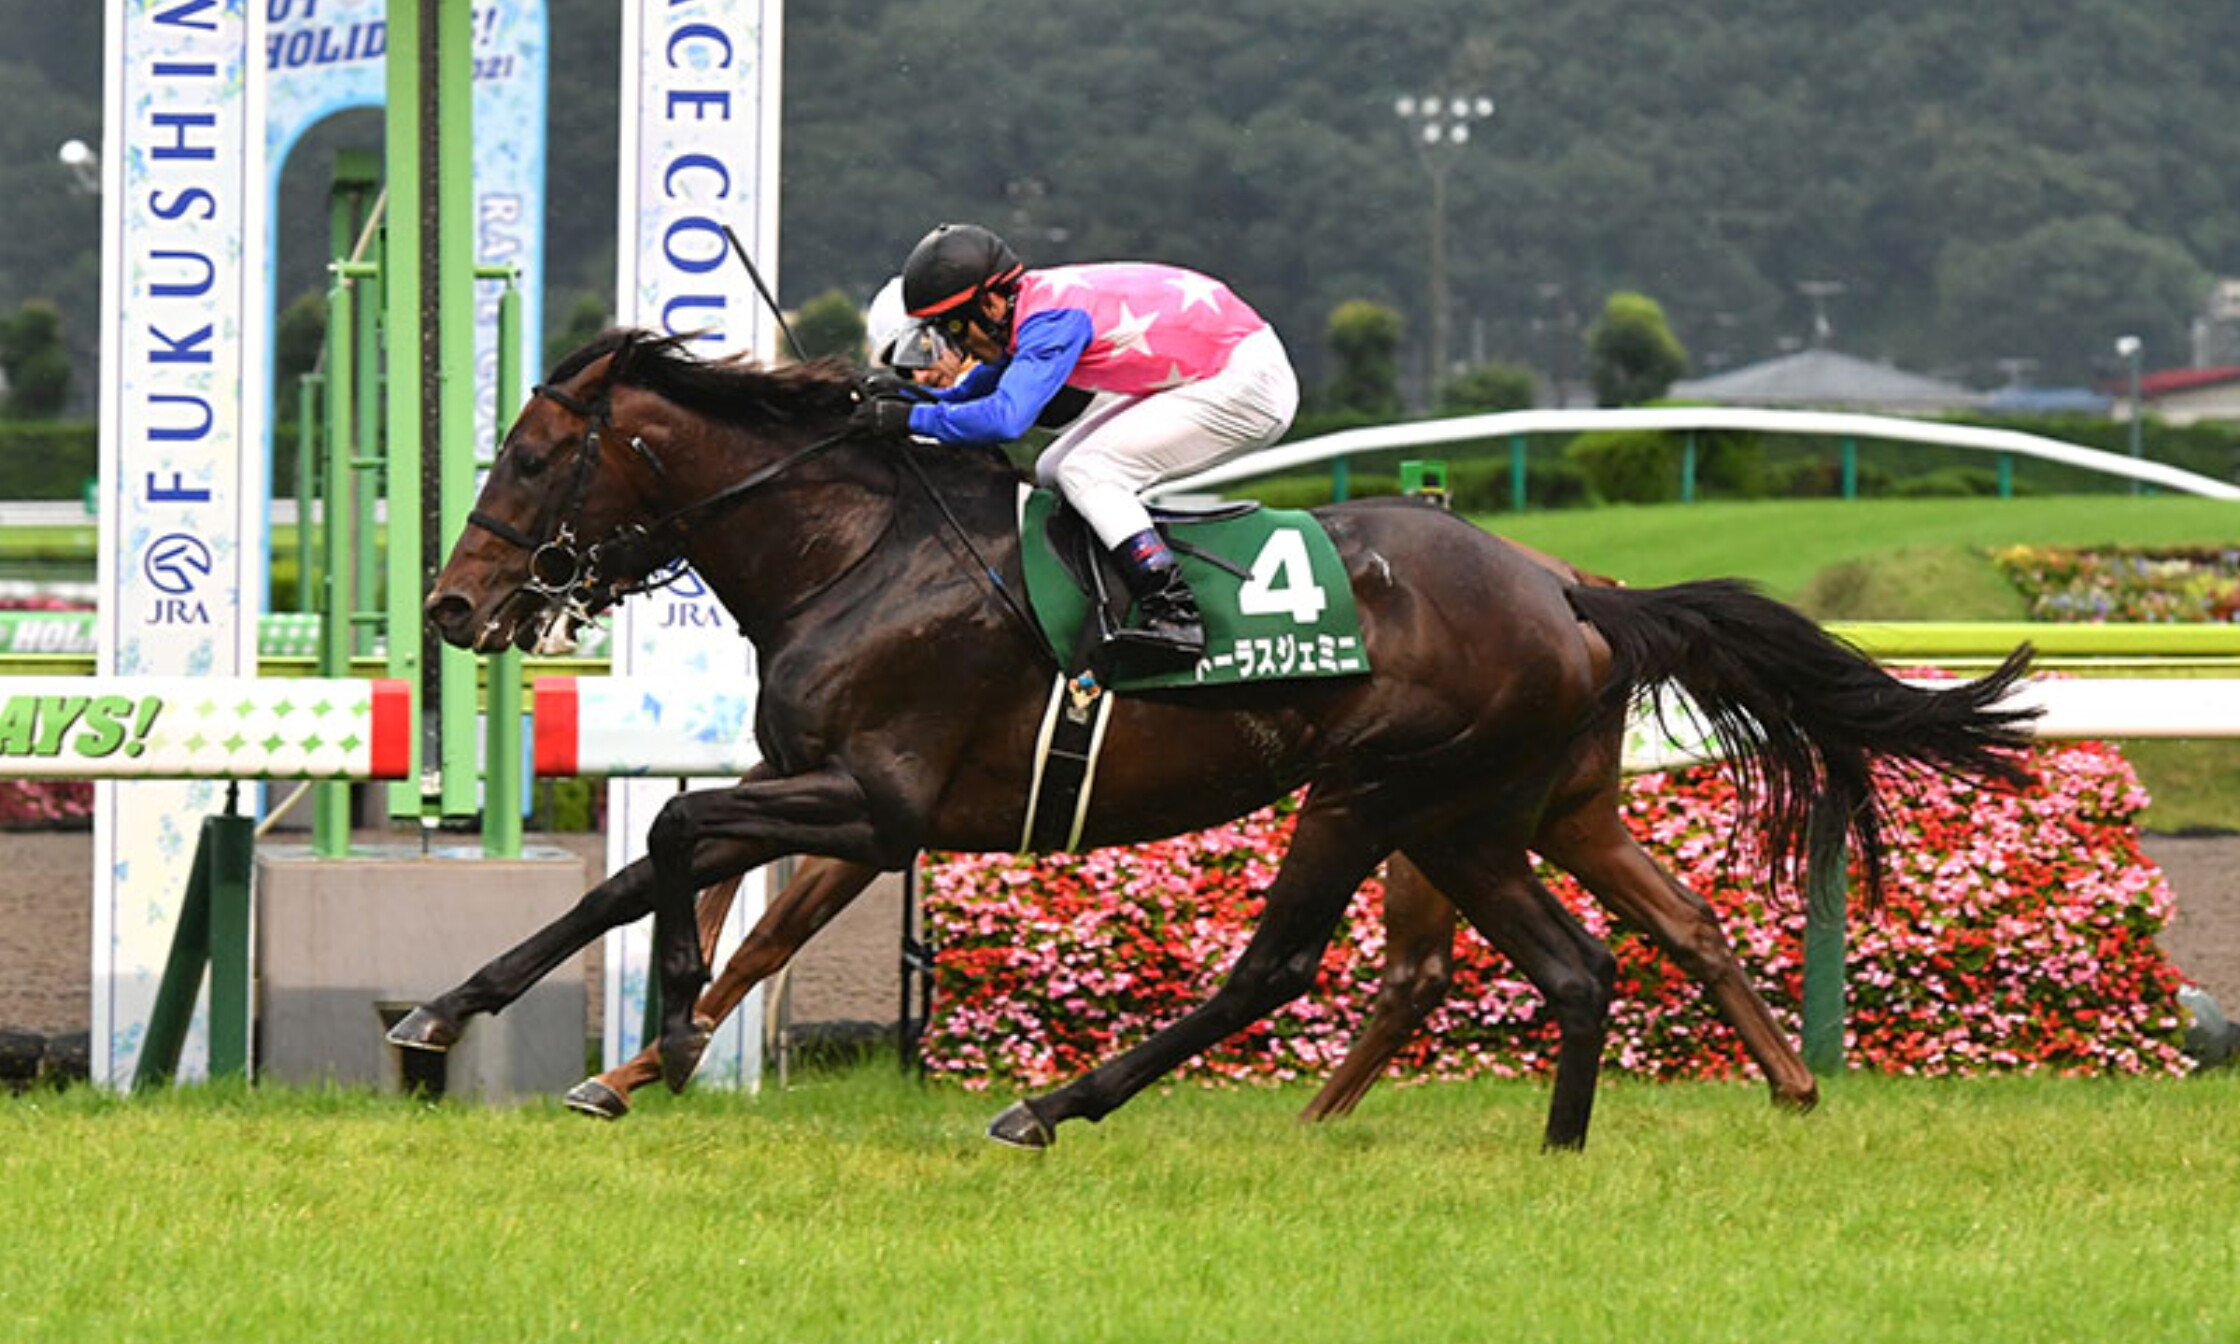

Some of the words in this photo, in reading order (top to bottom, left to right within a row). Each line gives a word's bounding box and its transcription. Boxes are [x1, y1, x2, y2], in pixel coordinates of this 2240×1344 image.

[1239, 528, 1327, 623] 4
[145, 599, 211, 624] JRA
[658, 602, 722, 628] JRA
